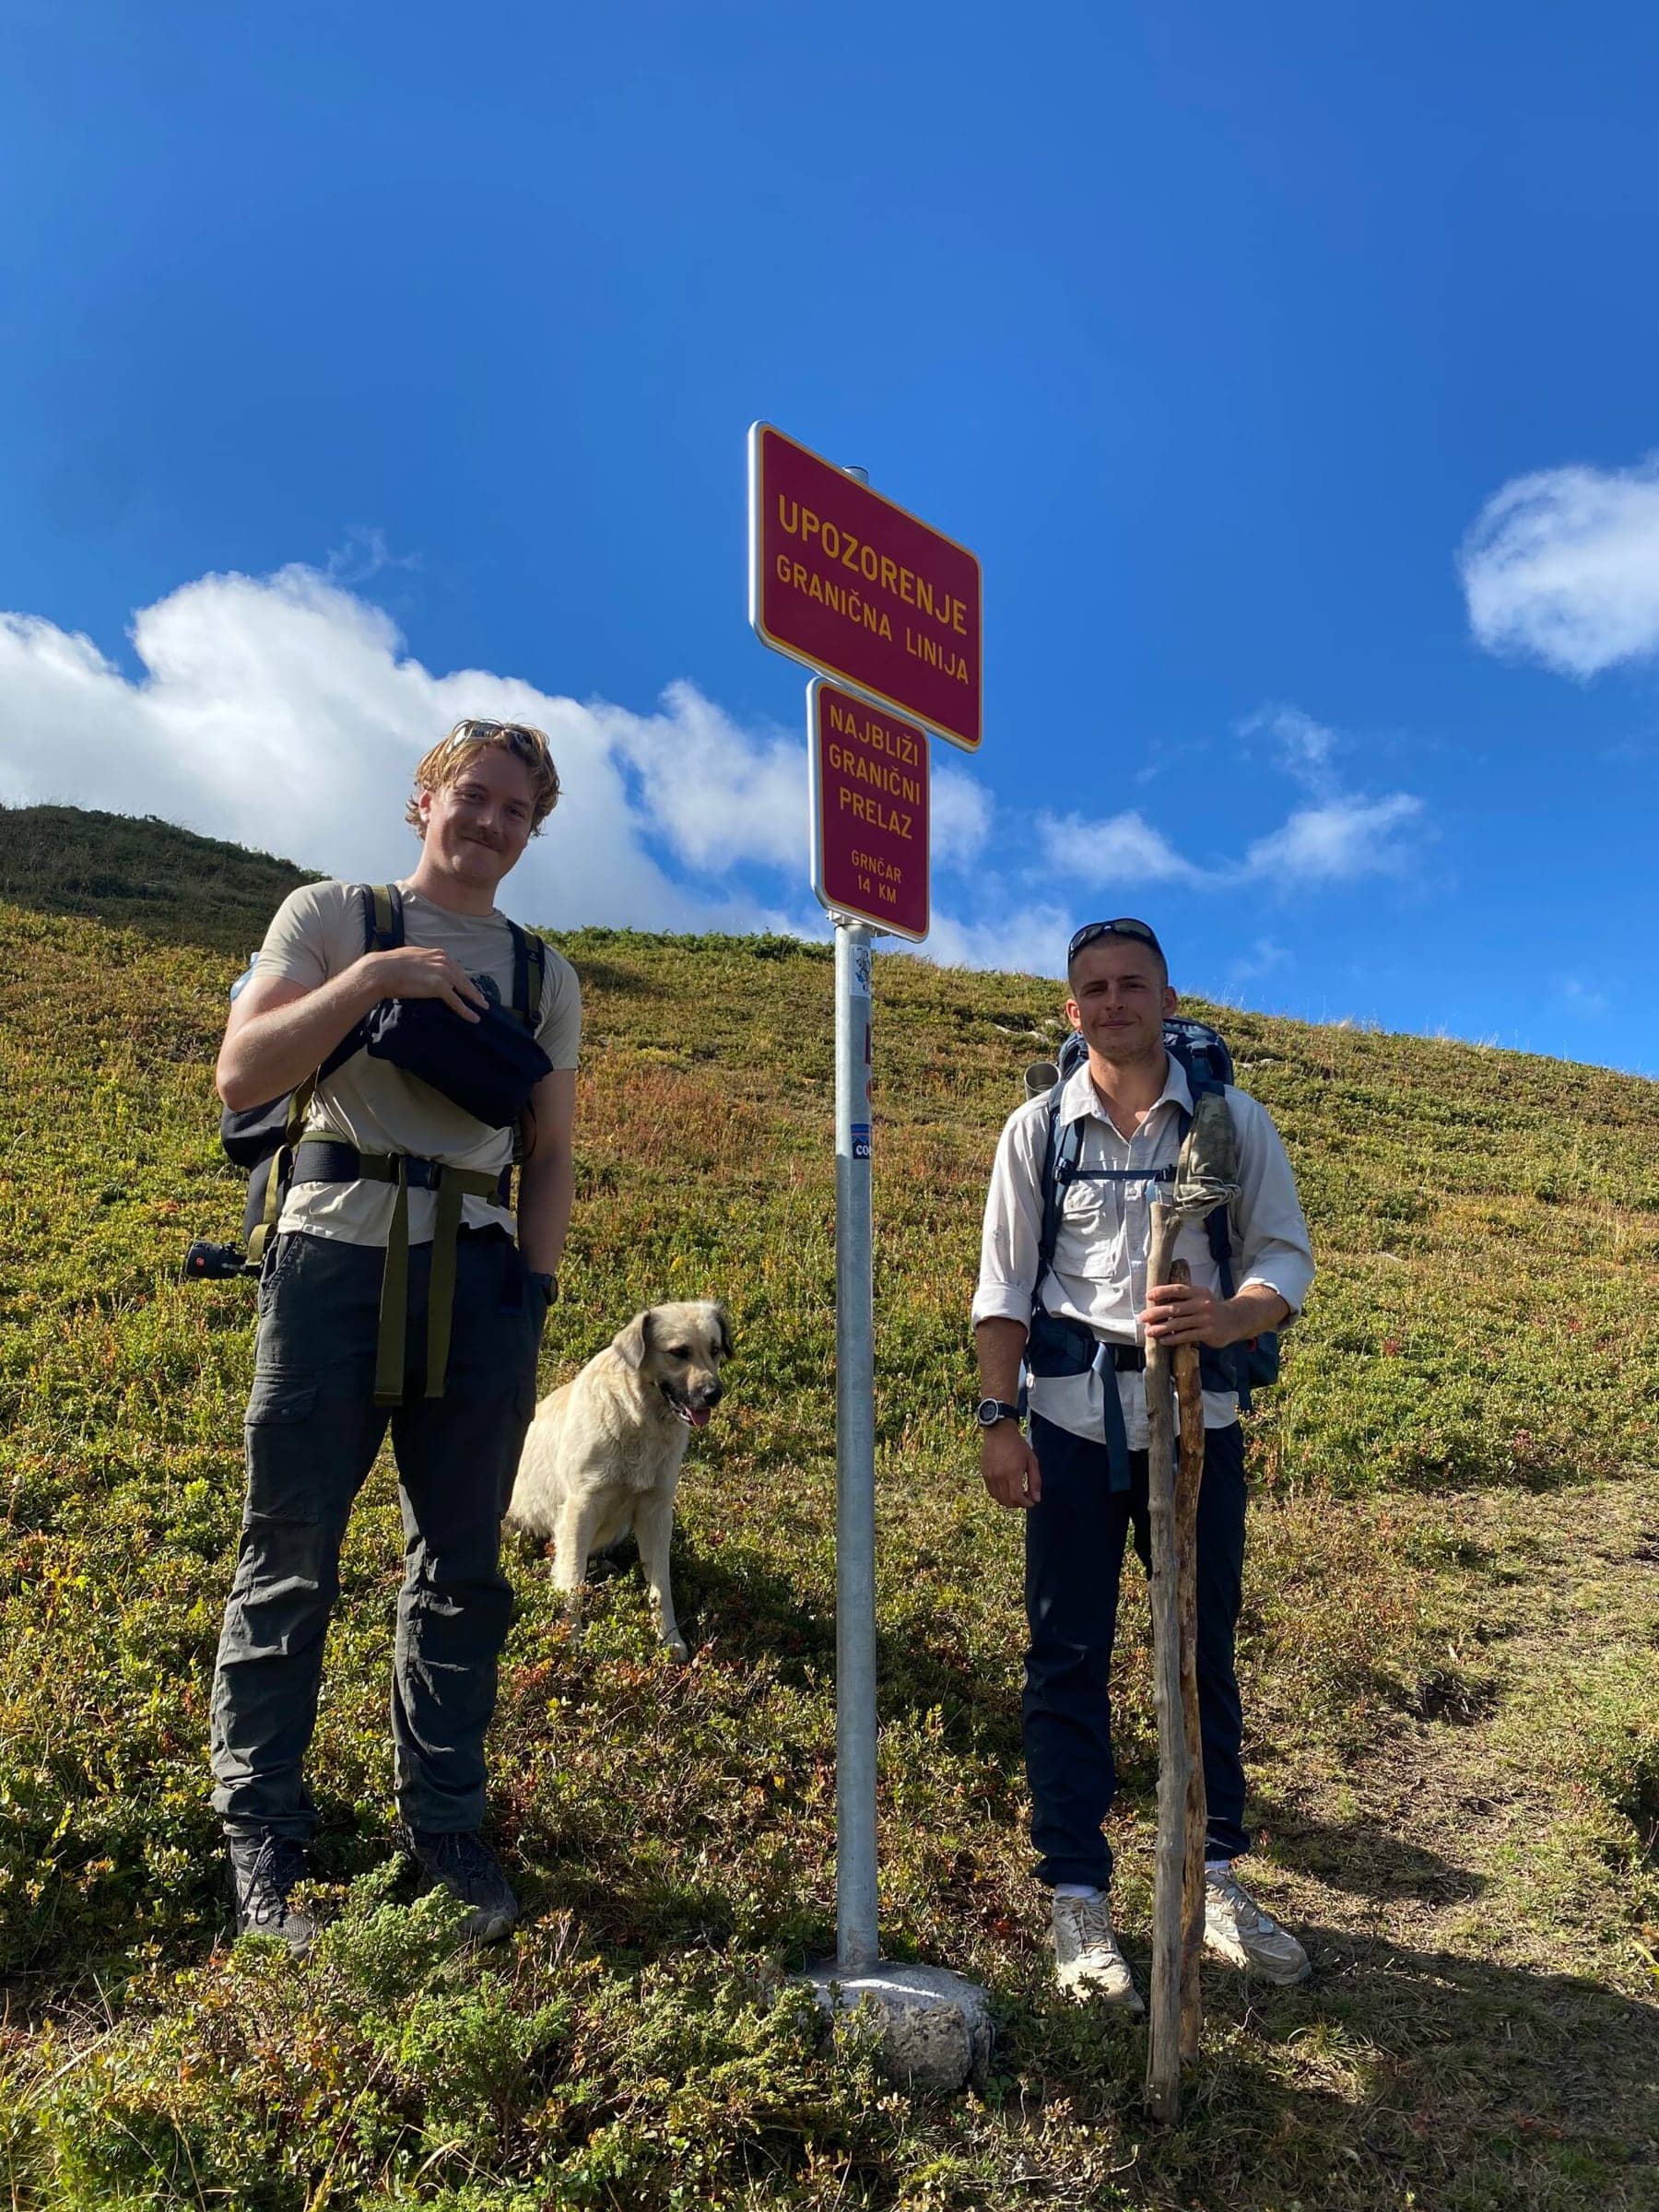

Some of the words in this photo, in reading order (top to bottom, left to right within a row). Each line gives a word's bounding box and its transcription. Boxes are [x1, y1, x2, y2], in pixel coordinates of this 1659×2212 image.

[779, 494, 968, 635] UPOZORENJE
[776, 554, 893, 641] GRANIČNA
[906, 627, 969, 685] LINIJA
[830, 704, 918, 767] NAJBLIŽI
[829, 744, 921, 806] GRANIČNI
[840, 786, 913, 840] PRELAZ
[851, 850, 901, 884] GRNČAR
[857, 875, 871, 893] 14
[878, 884, 897, 904] KM
